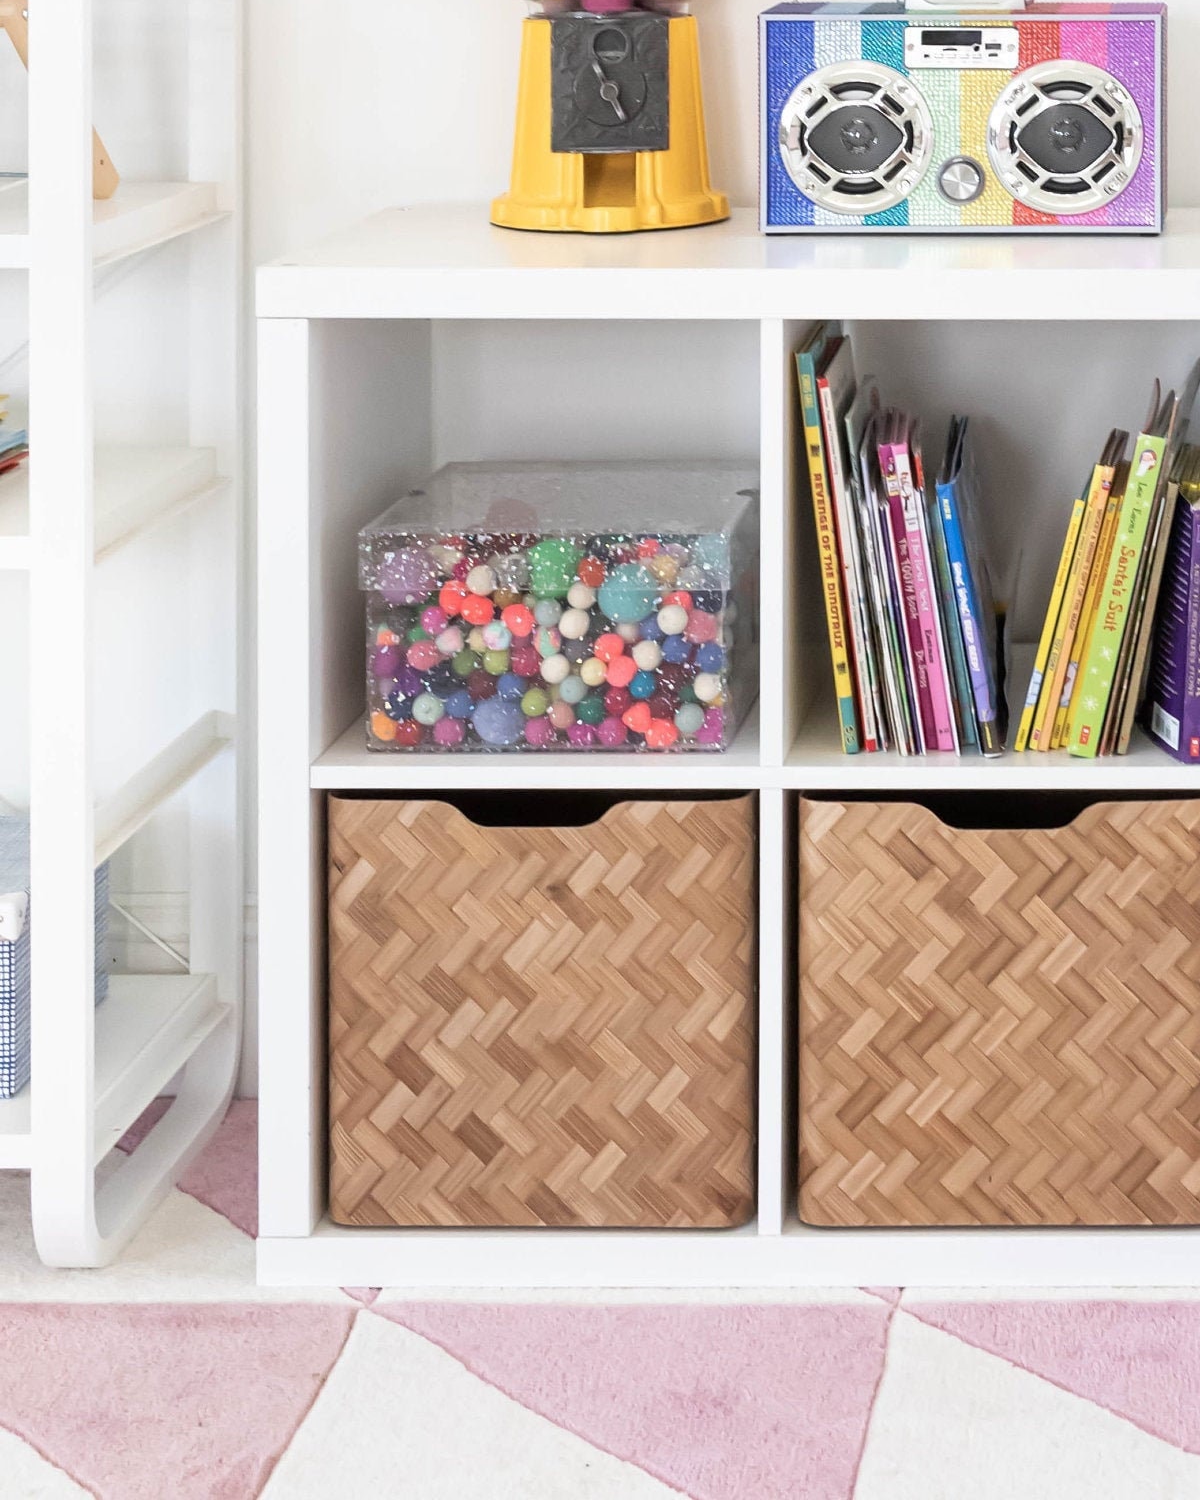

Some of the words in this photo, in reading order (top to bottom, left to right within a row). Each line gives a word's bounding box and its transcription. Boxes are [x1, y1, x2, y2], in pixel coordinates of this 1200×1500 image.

[814, 474, 828, 530] REVENGE
[822, 536, 830, 550] OF
[824, 555, 834, 577] THE
[1112, 547, 1136, 596] Santa's
[828, 583, 843, 647] DINOTRUX
[1104, 602, 1123, 631] Suit
